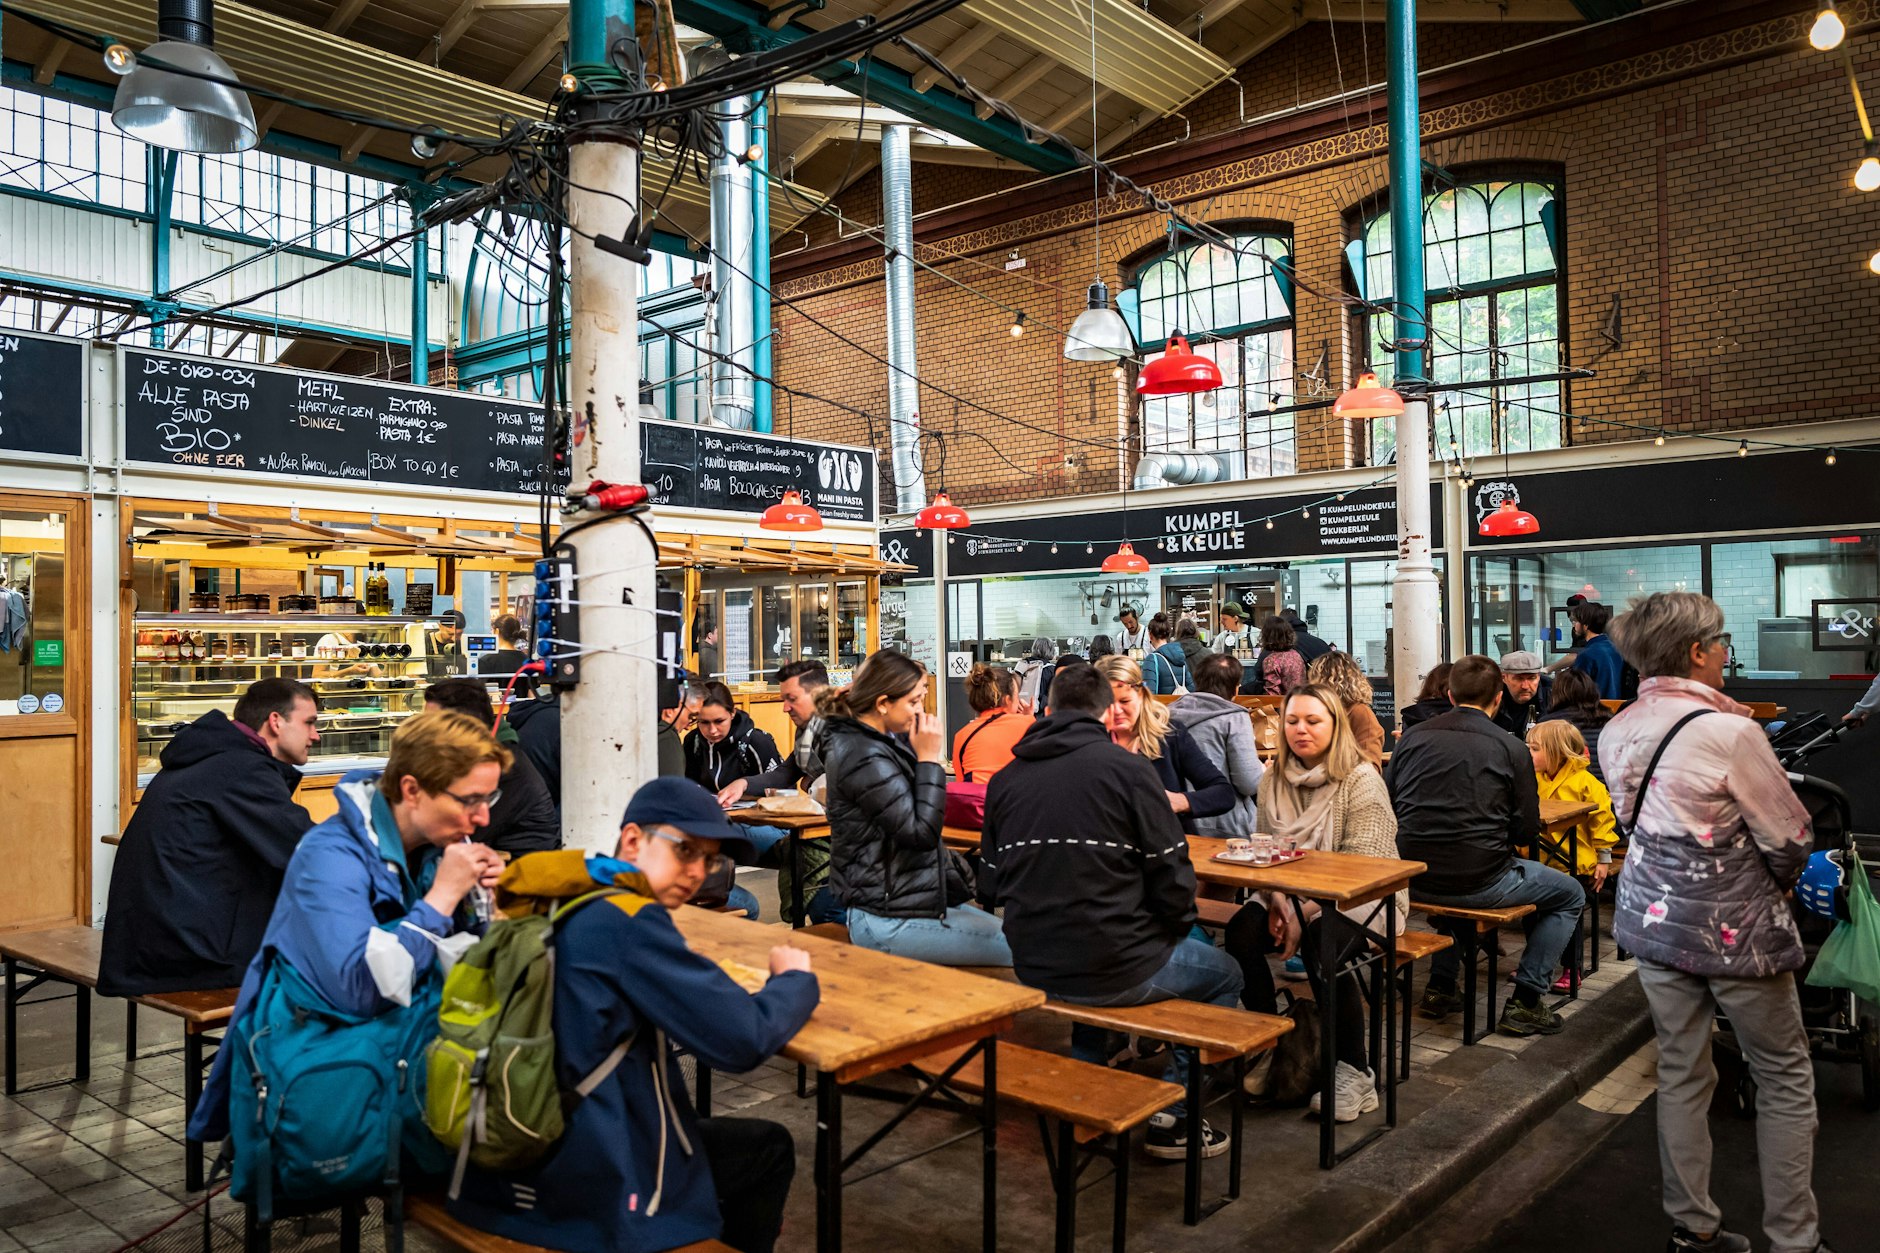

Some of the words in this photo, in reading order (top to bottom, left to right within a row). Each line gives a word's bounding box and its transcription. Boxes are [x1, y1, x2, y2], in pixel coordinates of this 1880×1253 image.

[143, 359, 255, 388] DE-ÖKO-034
[138, 381, 190, 406] ALLE
[203, 389, 249, 410] PASTA
[298, 378, 344, 400] MEHL
[298, 400, 373, 420] HARTWEIZEN
[388, 397, 437, 416] EXTRA:
[171, 407, 212, 423] SIND
[299, 415, 345, 431] DINKEL
[496, 411, 523, 426] PASTA
[430, 420, 448, 431] 0,50
[380, 426, 412, 442] PASTA
[496, 431, 519, 446] PASTA
[704, 437, 723, 450] PASTA
[173, 452, 209, 464] OHNE
[216, 454, 245, 467] EIER
[371, 452, 397, 470] BOX
[403, 459, 419, 471] TO
[421, 461, 437, 475] GO
[496, 456, 520, 473] PASTA
[340, 461, 367, 477] GNOCCHI
[795, 465, 802, 478] 9
[655, 473, 673, 492] 10
[704, 474, 721, 492] PASTA
[729, 476, 784, 499] BOLOGNESE
[817, 493, 835, 503] MANI
[835, 495, 843, 504] IN
[843, 495, 864, 506] PASTA
[1327, 501, 1397, 514] KUMPELUNDKEULE
[833, 510, 850, 519] freshly
[1165, 511, 1244, 533] KUMPEL
[1328, 513, 1380, 525] KUMPELKEULE
[1328, 524, 1370, 535] KUKBERLIN
[1166, 535, 1180, 553] &
[1182, 531, 1245, 552] KEULE
[1320, 534, 1398, 546] WWW.KUMPELUNDKEUL
